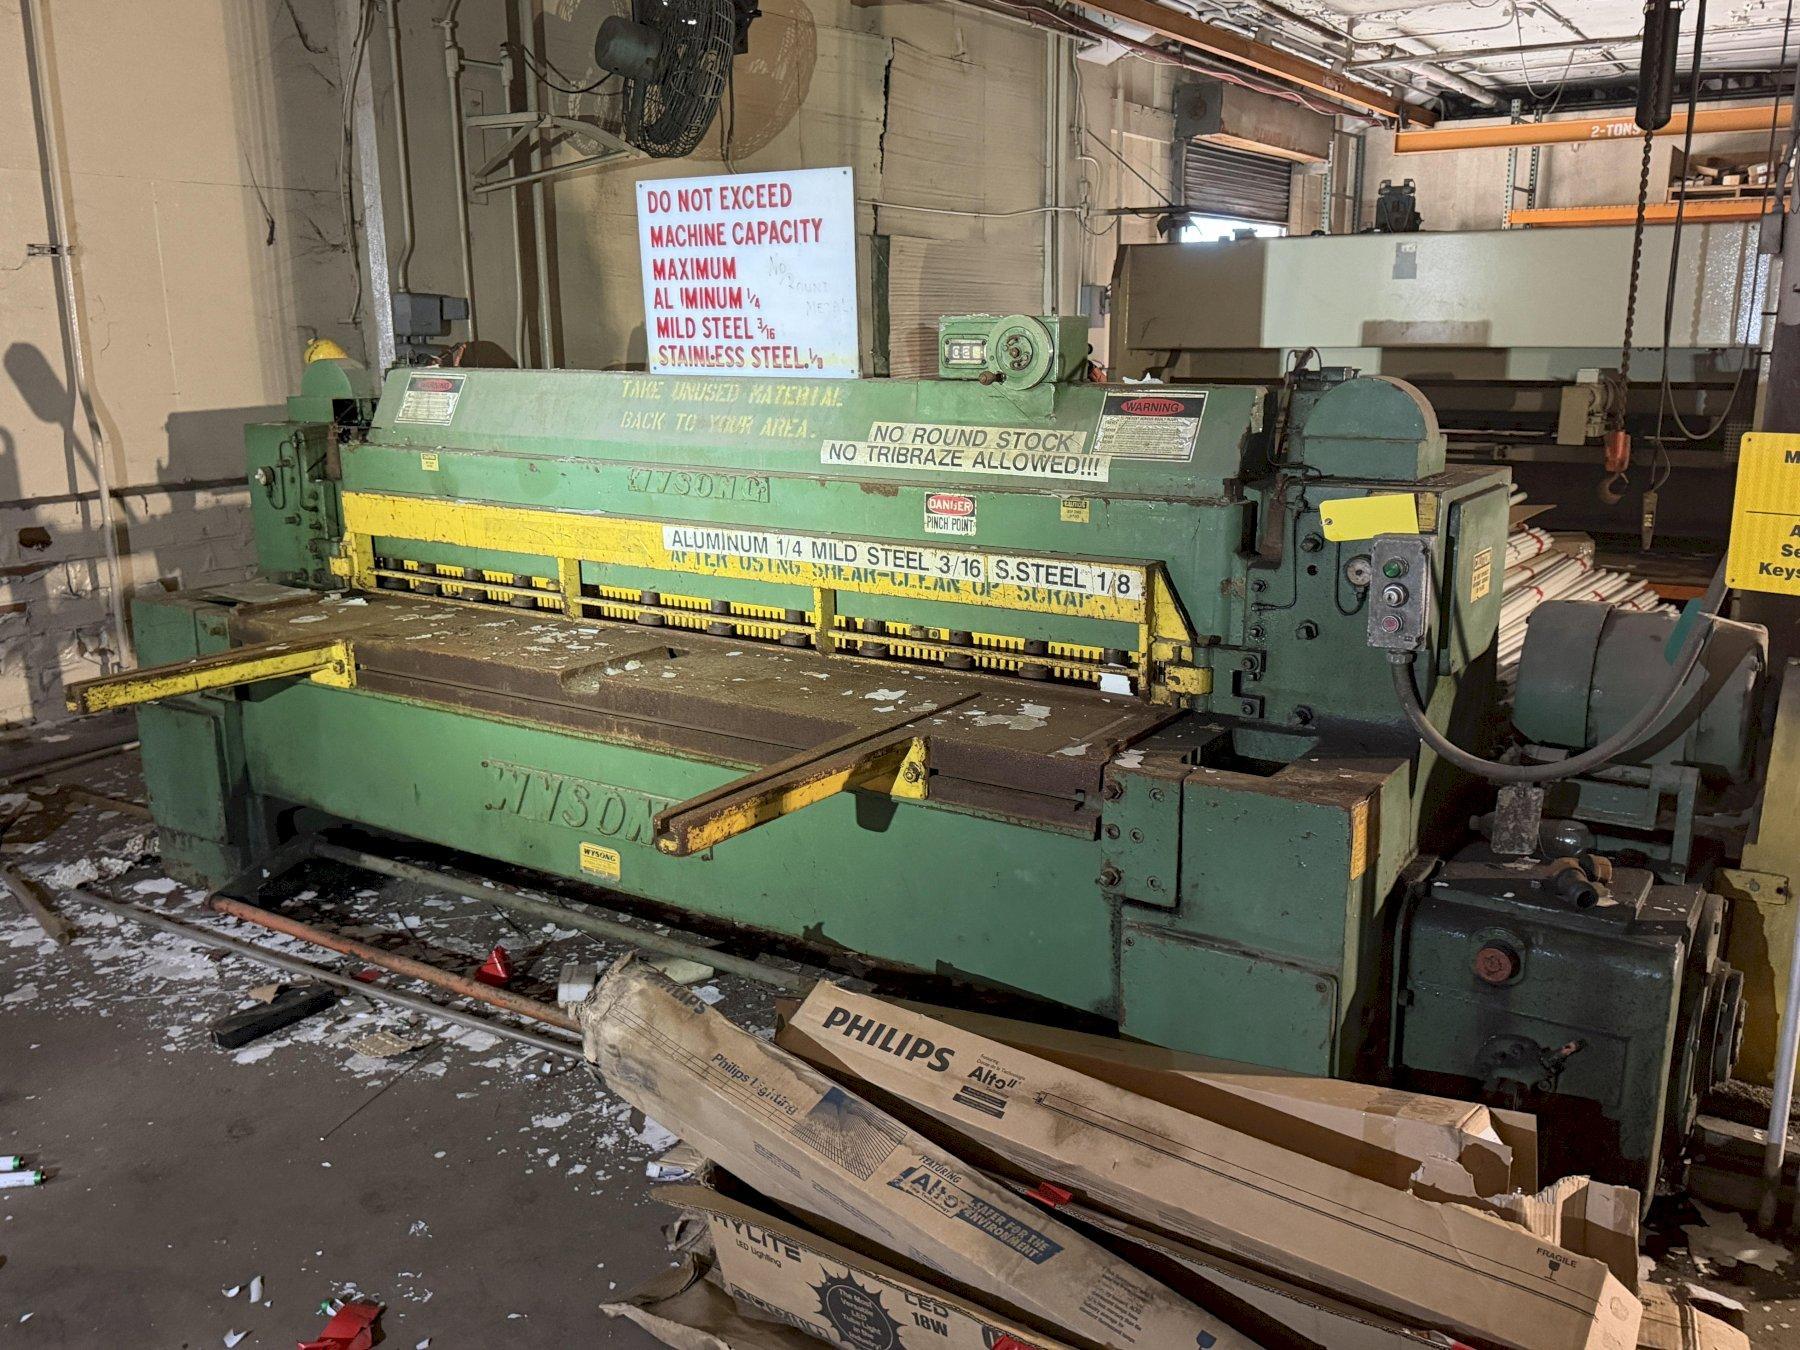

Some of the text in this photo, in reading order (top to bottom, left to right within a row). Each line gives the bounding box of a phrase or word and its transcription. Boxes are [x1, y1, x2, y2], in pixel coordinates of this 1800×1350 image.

[1590, 123, 1641, 138] 2-TONS
[647, 182, 793, 214] DO NOT EXCEED
[650, 218, 823, 248] MACHINE CAPACITY
[653, 256, 737, 281] MAXIMUM
[656, 316, 776, 340] MILD STEEL 3/16
[658, 344, 745, 368] STAINLESS
[621, 379, 665, 400] TAKE
[672, 381, 741, 403] UNUSED
[1126, 402, 1181, 413] WARNING
[620, 411, 666, 432] BACK
[676, 413, 696, 432] TO
[709, 414, 754, 435] YOUR
[873, 425, 1075, 453] NO ROUND STOCK
[829, 442, 1100, 477] NO TRIBRAZE ALLOWED!!!
[927, 498, 973, 512] DANGER
[927, 515, 974, 533] PINCH POINT
[672, 530, 1131, 594] ALUMINUM 1/4 MILD STEEL 3/16 S.STEEL 1/8
[584, 848, 616, 862] WYSONG
[822, 1006, 956, 1073] PHILIPS
[712, 1053, 799, 1116] Philips Lighting
[919, 1155, 962, 1183] FEATURING
[965, 1208, 1039, 1258] ENVIRONMENT
[977, 1202, 1051, 1252] SAFER FOR THE
[736, 1238, 782, 1268] LED Lighting
[1536, 1247, 1578, 1268] FRAGILE
[911, 1311, 948, 1336] 18W
